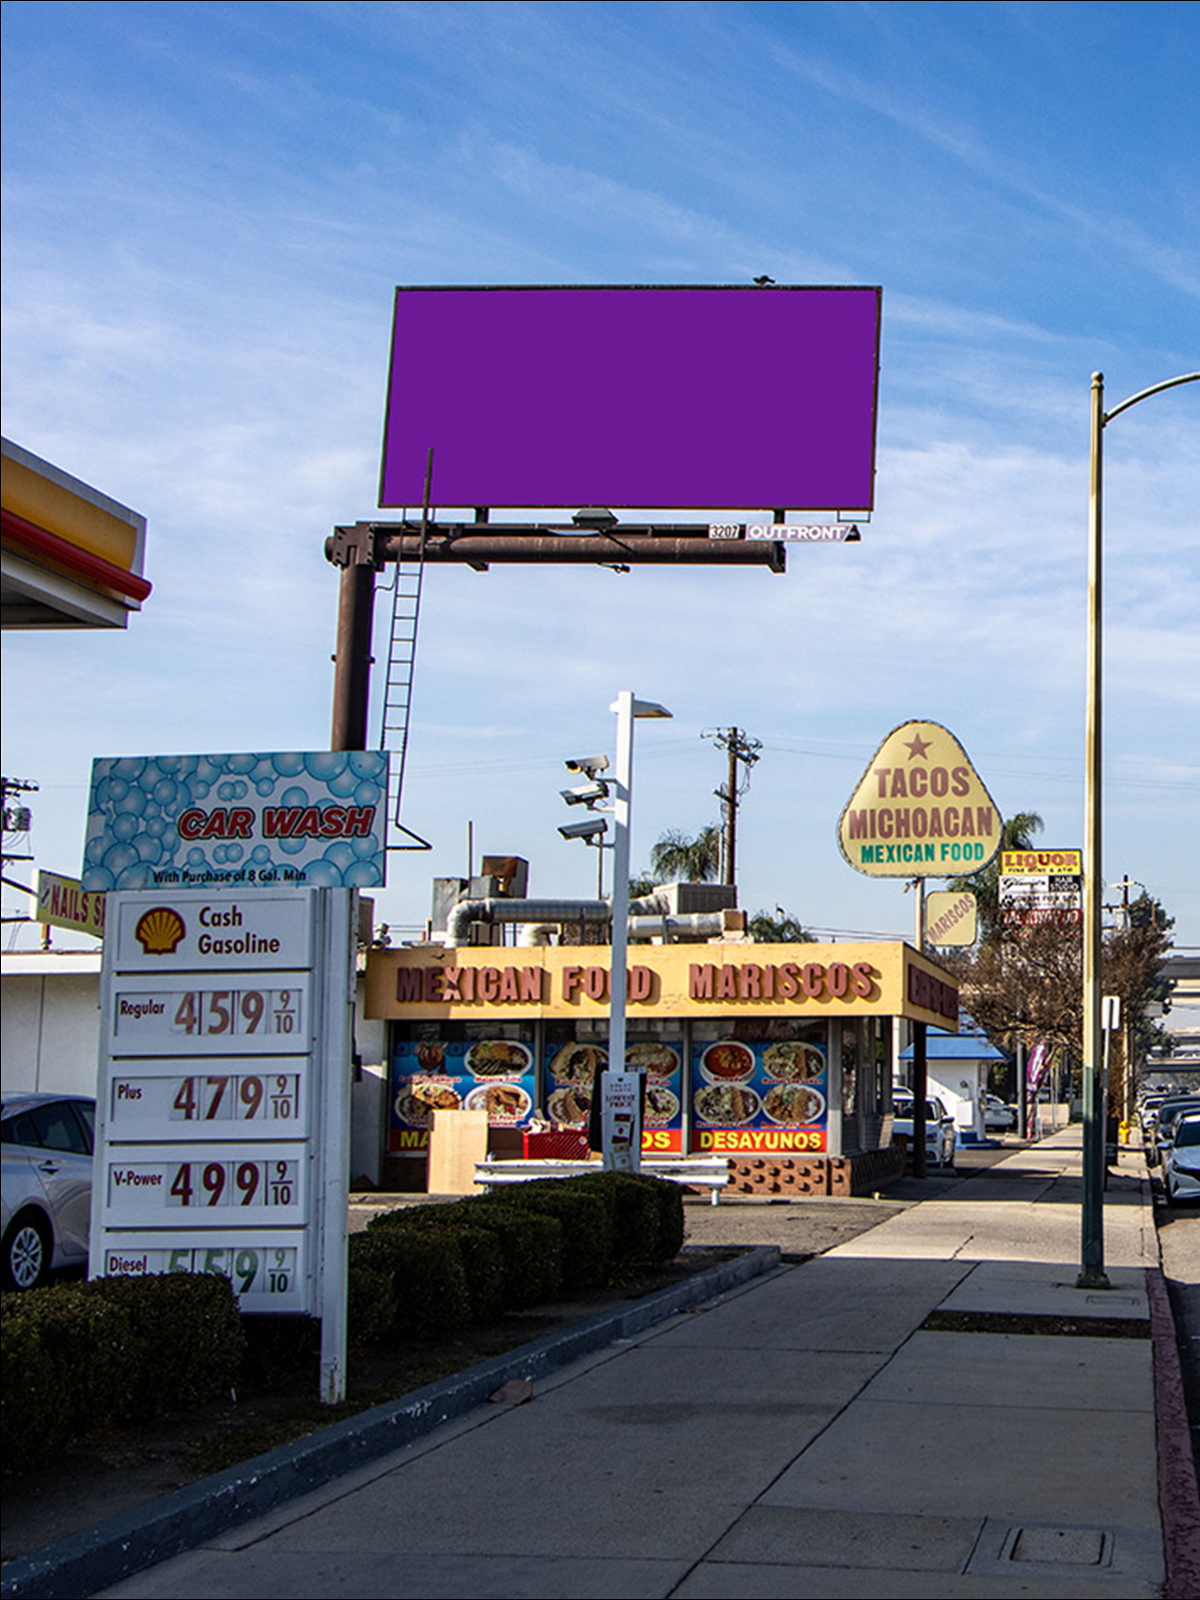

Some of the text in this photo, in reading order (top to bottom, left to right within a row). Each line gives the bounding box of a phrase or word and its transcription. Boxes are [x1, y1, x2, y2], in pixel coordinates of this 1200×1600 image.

[711, 526, 738, 538] 3207
[750, 526, 846, 540] OUTFRONT
[873, 766, 970, 798] TACOS
[178, 806, 377, 840] CAR WASH
[849, 806, 993, 840] MICHOACAN
[861, 843, 984, 864] MEXICAN FOOD
[1004, 853, 1078, 869] LIQUOR
[152, 868, 306, 883] With Purchase of 8 Gal. Min
[50, 884, 89, 924] NAILS
[199, 906, 243, 928] Cash
[926, 894, 975, 944] MARISCOS
[199, 932, 280, 955] Gasoline
[396, 965, 651, 1001] MEXICAN FOD
[689, 962, 875, 999] MARISCOS
[120, 990, 264, 1036] Regular 459
[118, 1075, 264, 1120] Plus 479
[700, 1132, 822, 1149] DESAYUNOS
[113, 1161, 260, 1207] V-Power 499
[110, 1255, 147, 1272] Diesel
